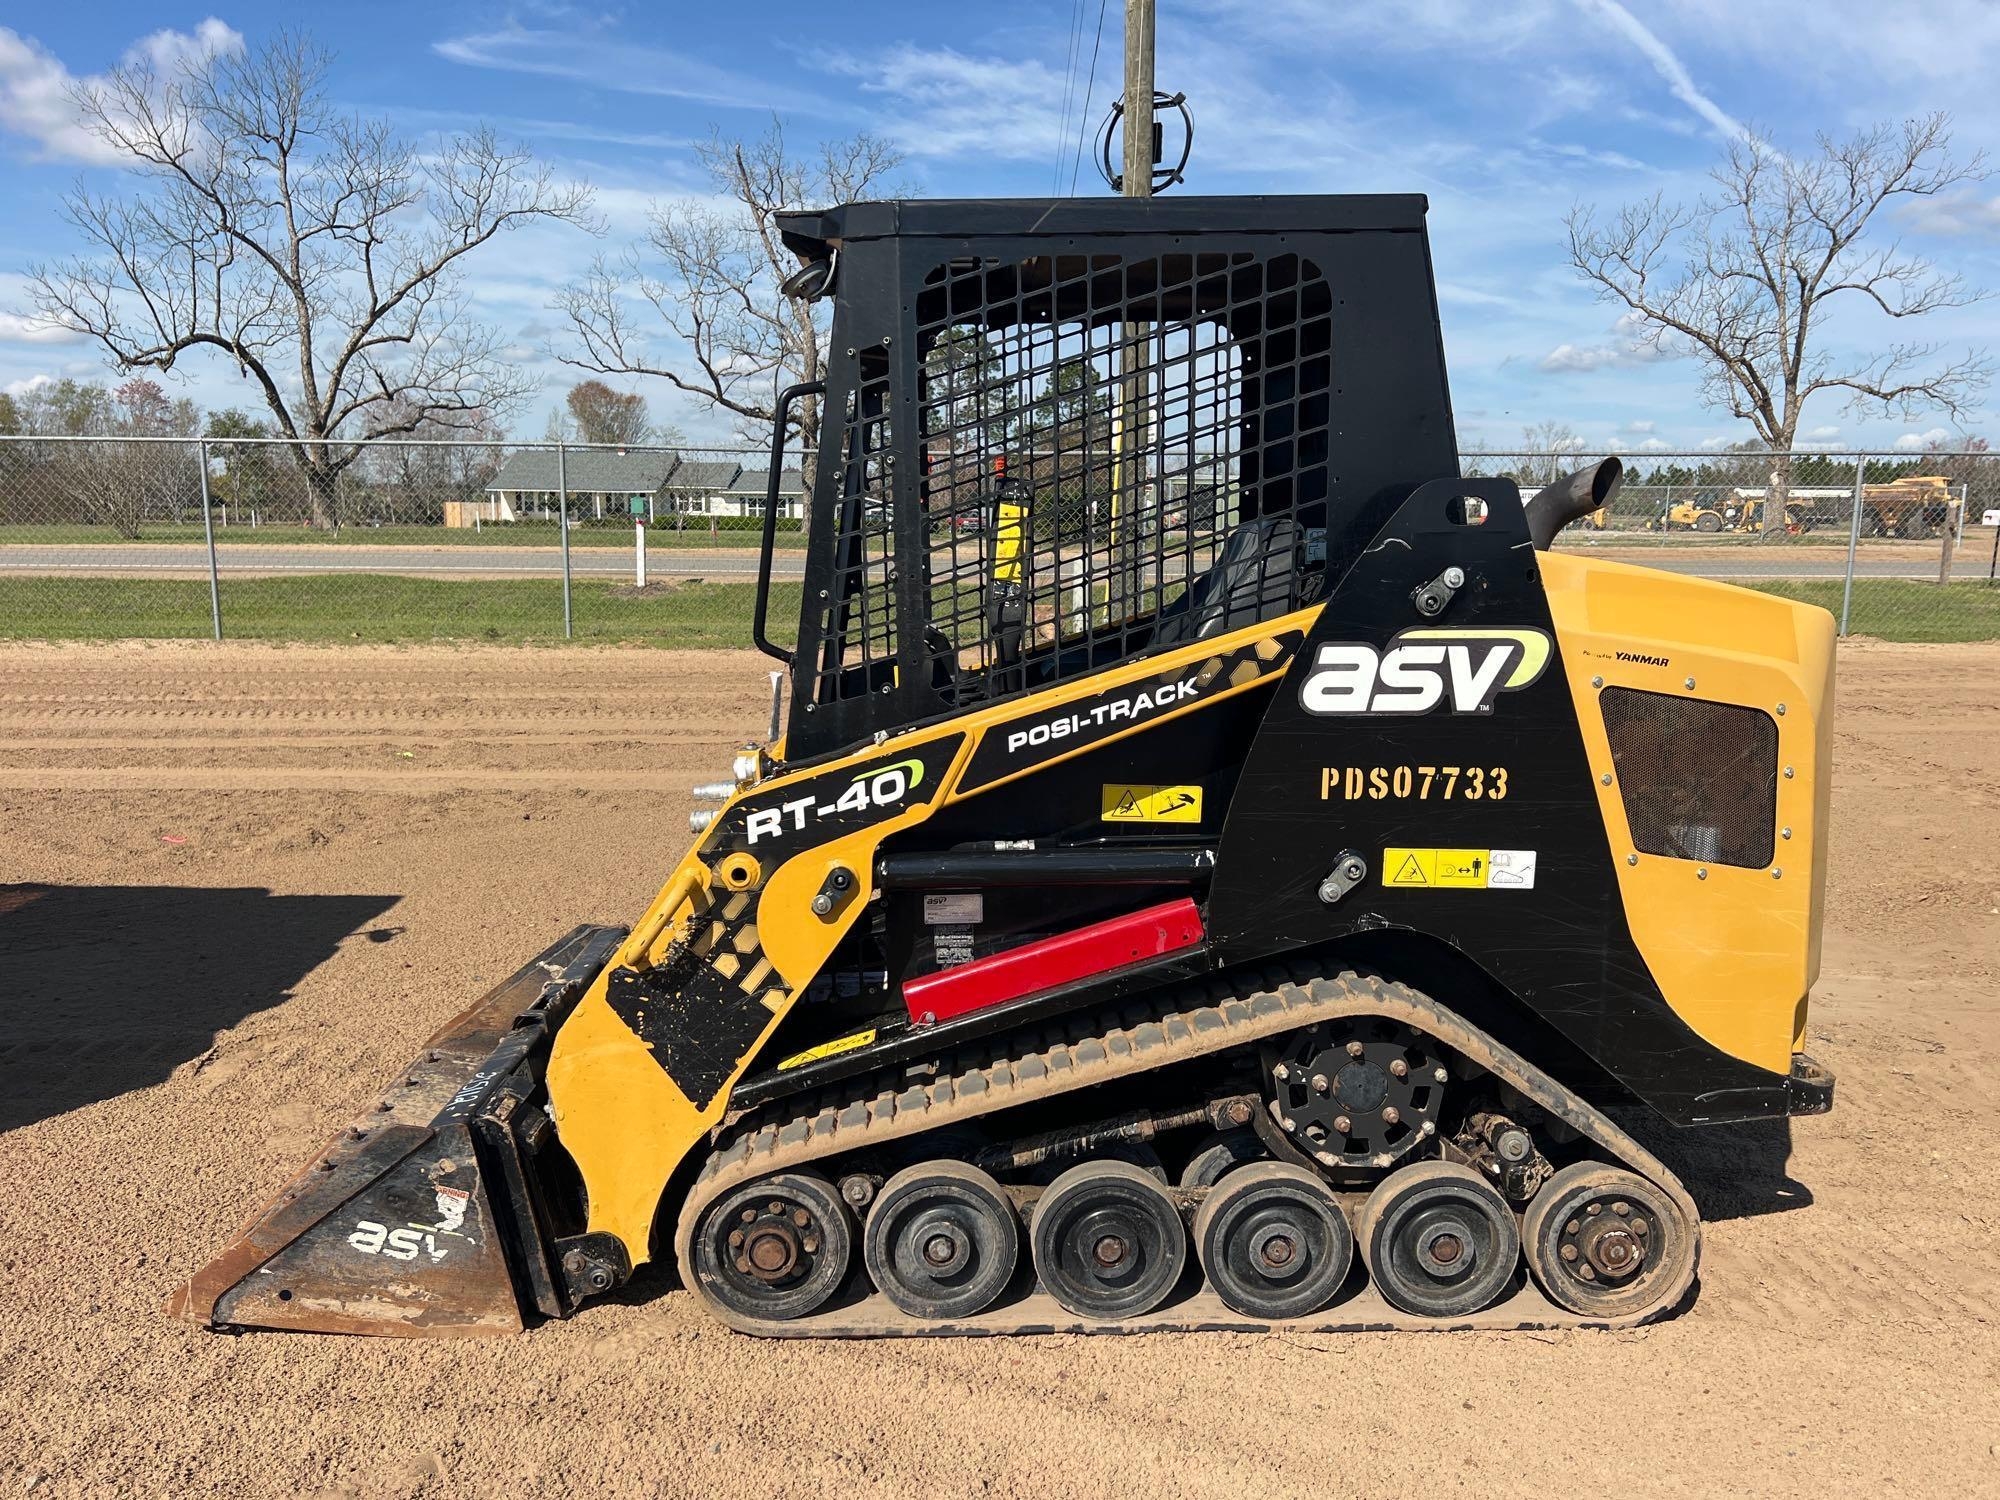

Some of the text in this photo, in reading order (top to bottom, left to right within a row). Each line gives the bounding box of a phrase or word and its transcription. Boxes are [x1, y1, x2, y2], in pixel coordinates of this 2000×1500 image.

[1615, 651, 1670, 667] YANMAR
[1008, 676, 1199, 753] POSI-TRACK
[1320, 765, 1509, 800] PDS07733
[746, 769, 906, 845] RT-40
[926, 896, 946, 905] asv
[436, 1185, 469, 1200] ARNING
